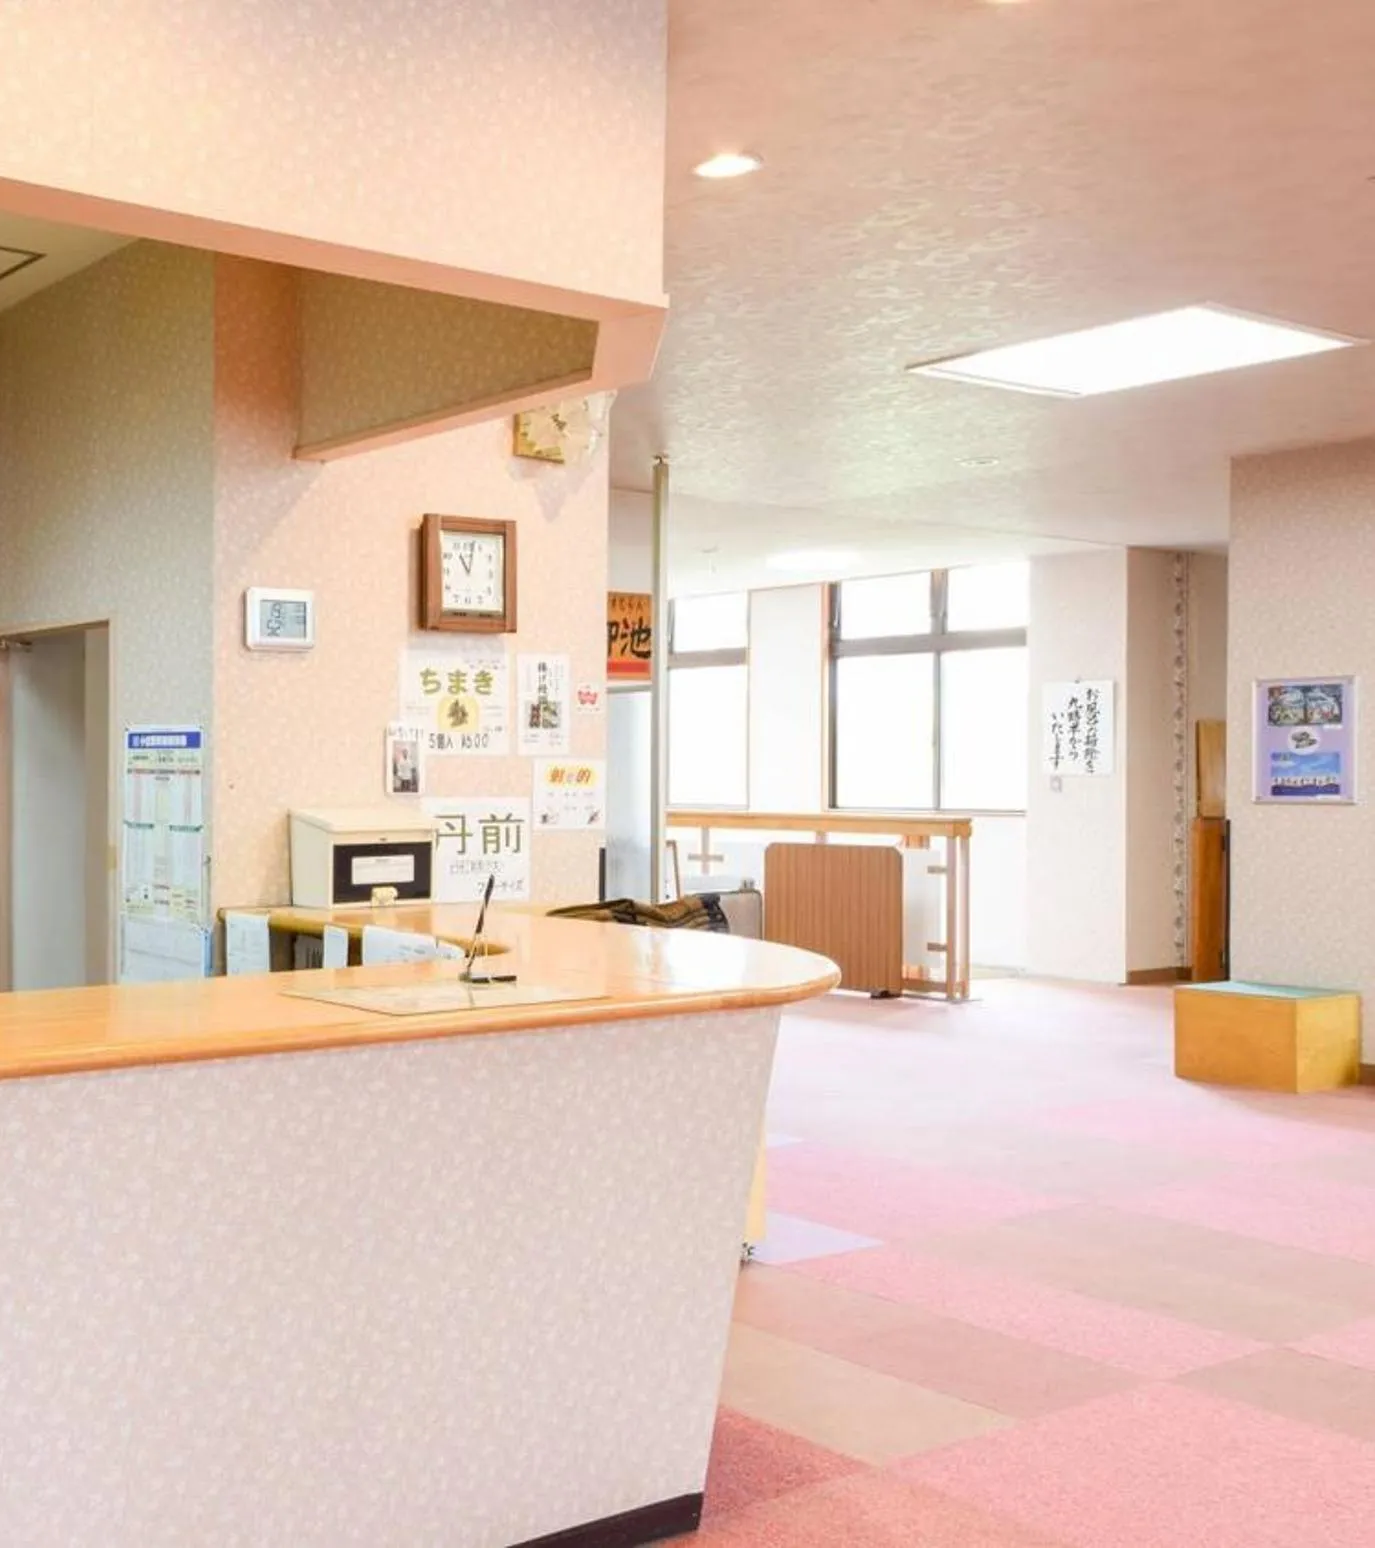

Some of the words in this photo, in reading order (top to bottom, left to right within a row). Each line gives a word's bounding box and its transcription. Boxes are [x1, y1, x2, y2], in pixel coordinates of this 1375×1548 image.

[419, 667, 493, 695] ちまき
[434, 812, 524, 855] 丹前
